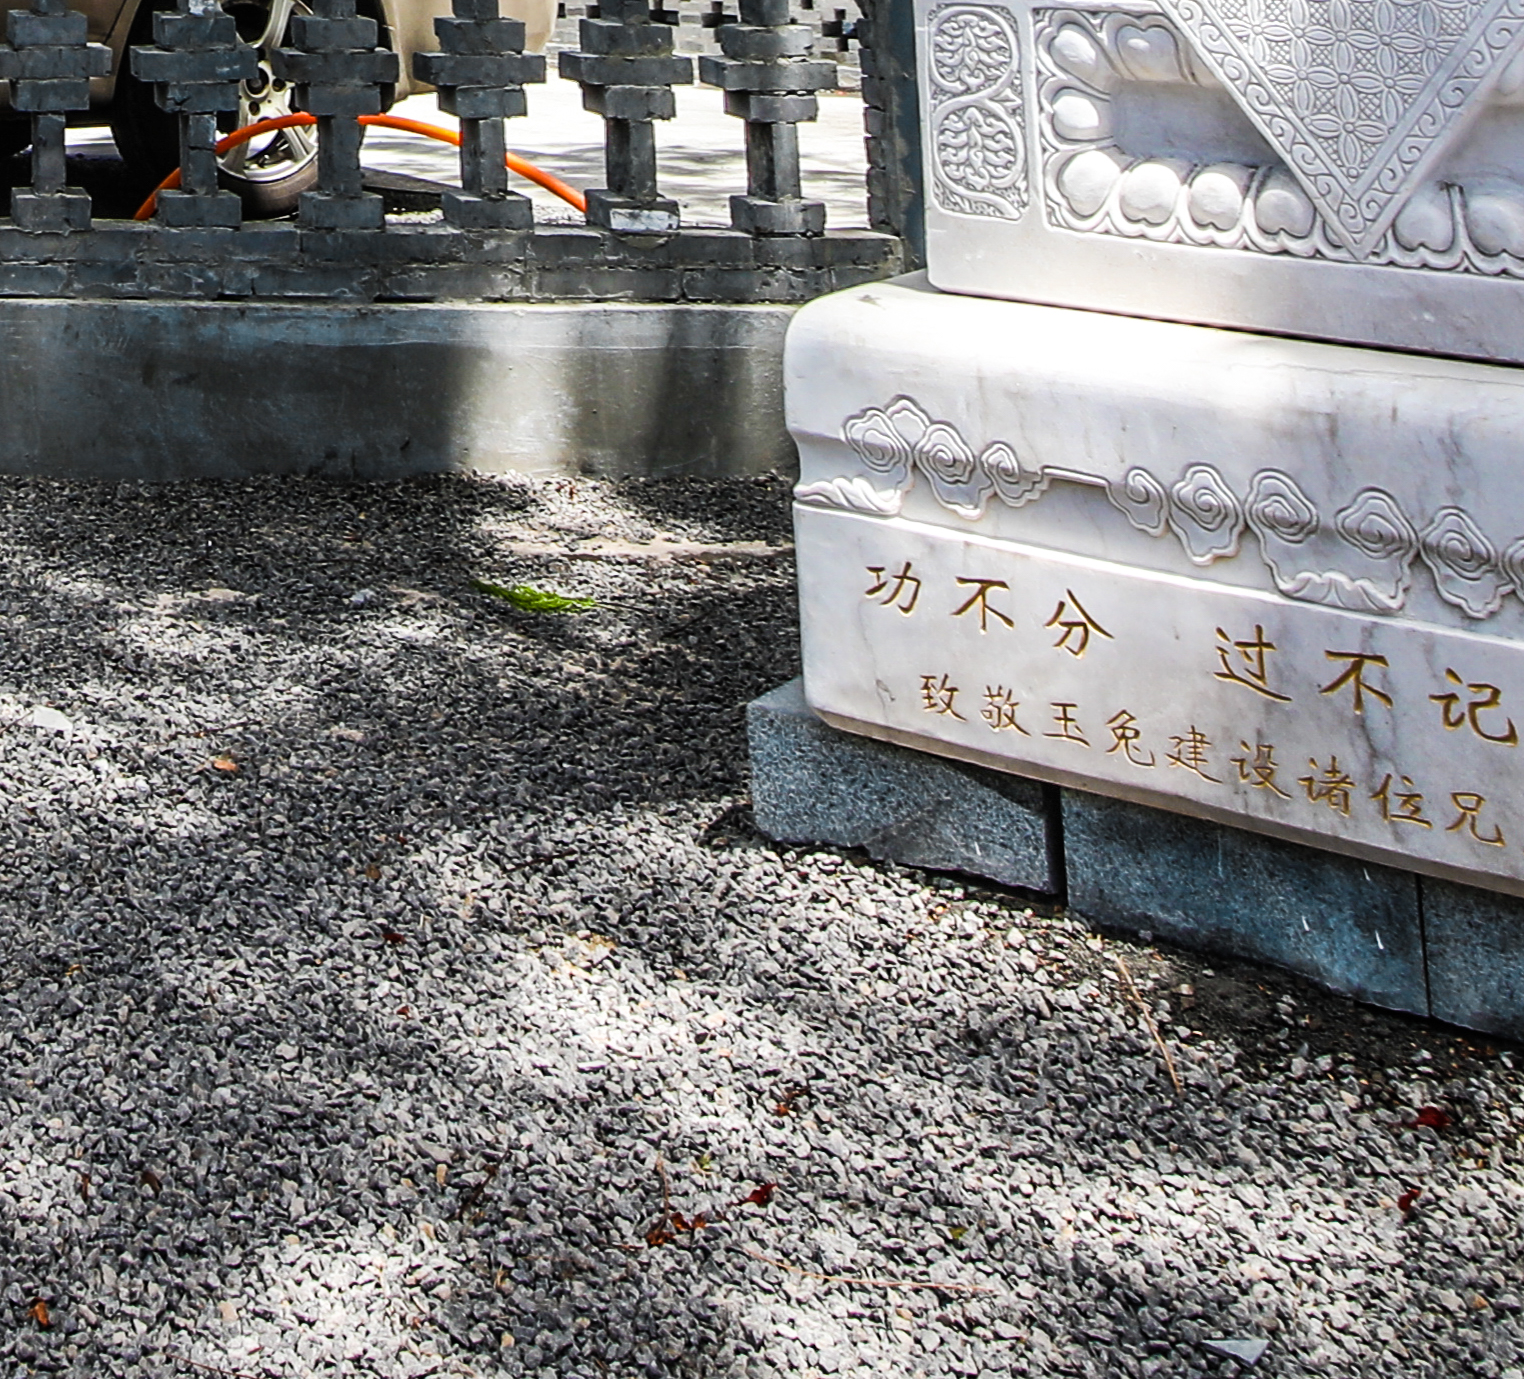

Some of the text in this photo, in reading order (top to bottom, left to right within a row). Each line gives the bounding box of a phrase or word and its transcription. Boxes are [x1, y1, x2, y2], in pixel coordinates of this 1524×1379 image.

[864, 560, 1115, 659] 功不分
[1213, 624, 1519, 746] 过不记
